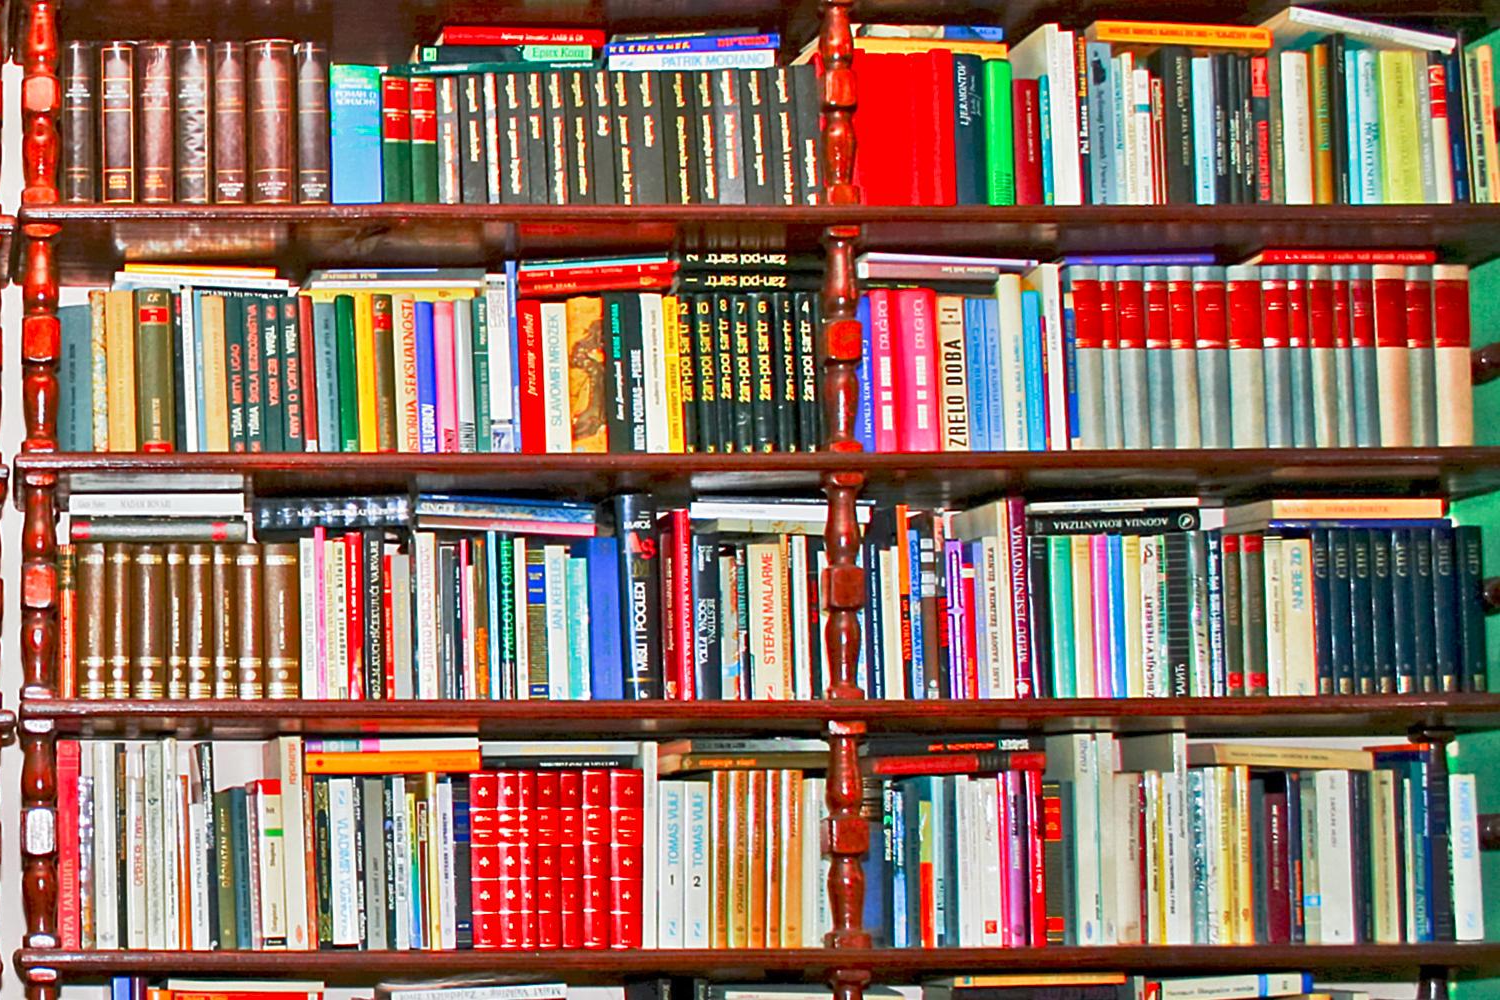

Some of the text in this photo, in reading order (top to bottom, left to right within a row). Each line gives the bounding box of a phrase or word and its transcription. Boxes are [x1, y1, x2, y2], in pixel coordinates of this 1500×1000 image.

[660, 53, 766, 68] PATRIK MODIANO
[958, 61, 970, 125] LJERMONTOV
[686, 253, 787, 265] žan-pol sartr 2
[705, 275, 788, 288] žan-pol sartr
[265, 325, 277, 355] TIŠMA
[285, 323, 297, 354] TIŠMA
[401, 299, 416, 395] SEKSUALNOSTI
[698, 321, 711, 353] sartr
[717, 318, 730, 351] sartr
[735, 322, 748, 354] sartr
[756, 320, 769, 352] sartr
[781, 320, 792, 352] sartr
[800, 320, 812, 352] sartr
[266, 357, 277, 376] BEZ
[700, 356, 714, 401] žan-pol
[720, 354, 732, 399] žan-pol
[737, 357, 751, 402] žan-pol
[802, 355, 816, 401] žan-pol
[230, 344, 243, 437] TIŠMA MRTVI UGAO
[247, 373, 260, 436] TIŠMA ŠKOLA
[550, 366, 563, 426] SLAVOMIR
[943, 338, 967, 447] ZRELO DOBA
[288, 403, 300, 439] BLAMU
[1053, 517, 1169, 529] AGONIJA ROMANTIZMA
[369, 540, 380, 582] VARVARE
[1013, 525, 1027, 622] JESENJINOVIMA
[503, 596, 514, 659] PAKLOVI
[552, 609, 563, 630] JAN
[634, 582, 647, 632] POGLEDI
[762, 553, 775, 665] STEFAN MALARME
[987, 547, 1000, 688] RANI RADOVI ŽELIMIRA ŽILNIKA
[1144, 594, 1153, 643] HERBERT
[337, 617, 346, 666] razgovori
[635, 643, 648, 671] MISLI
[667, 790, 680, 865] TOMAS VULF
[691, 791, 704, 887] 2 TOMAS VULF
[1458, 782, 1473, 859] KLOD SIMON
[337, 818, 351, 873] VLADIMIR
[62, 859, 75, 947] ЂУРА ЈАКШИЋ
